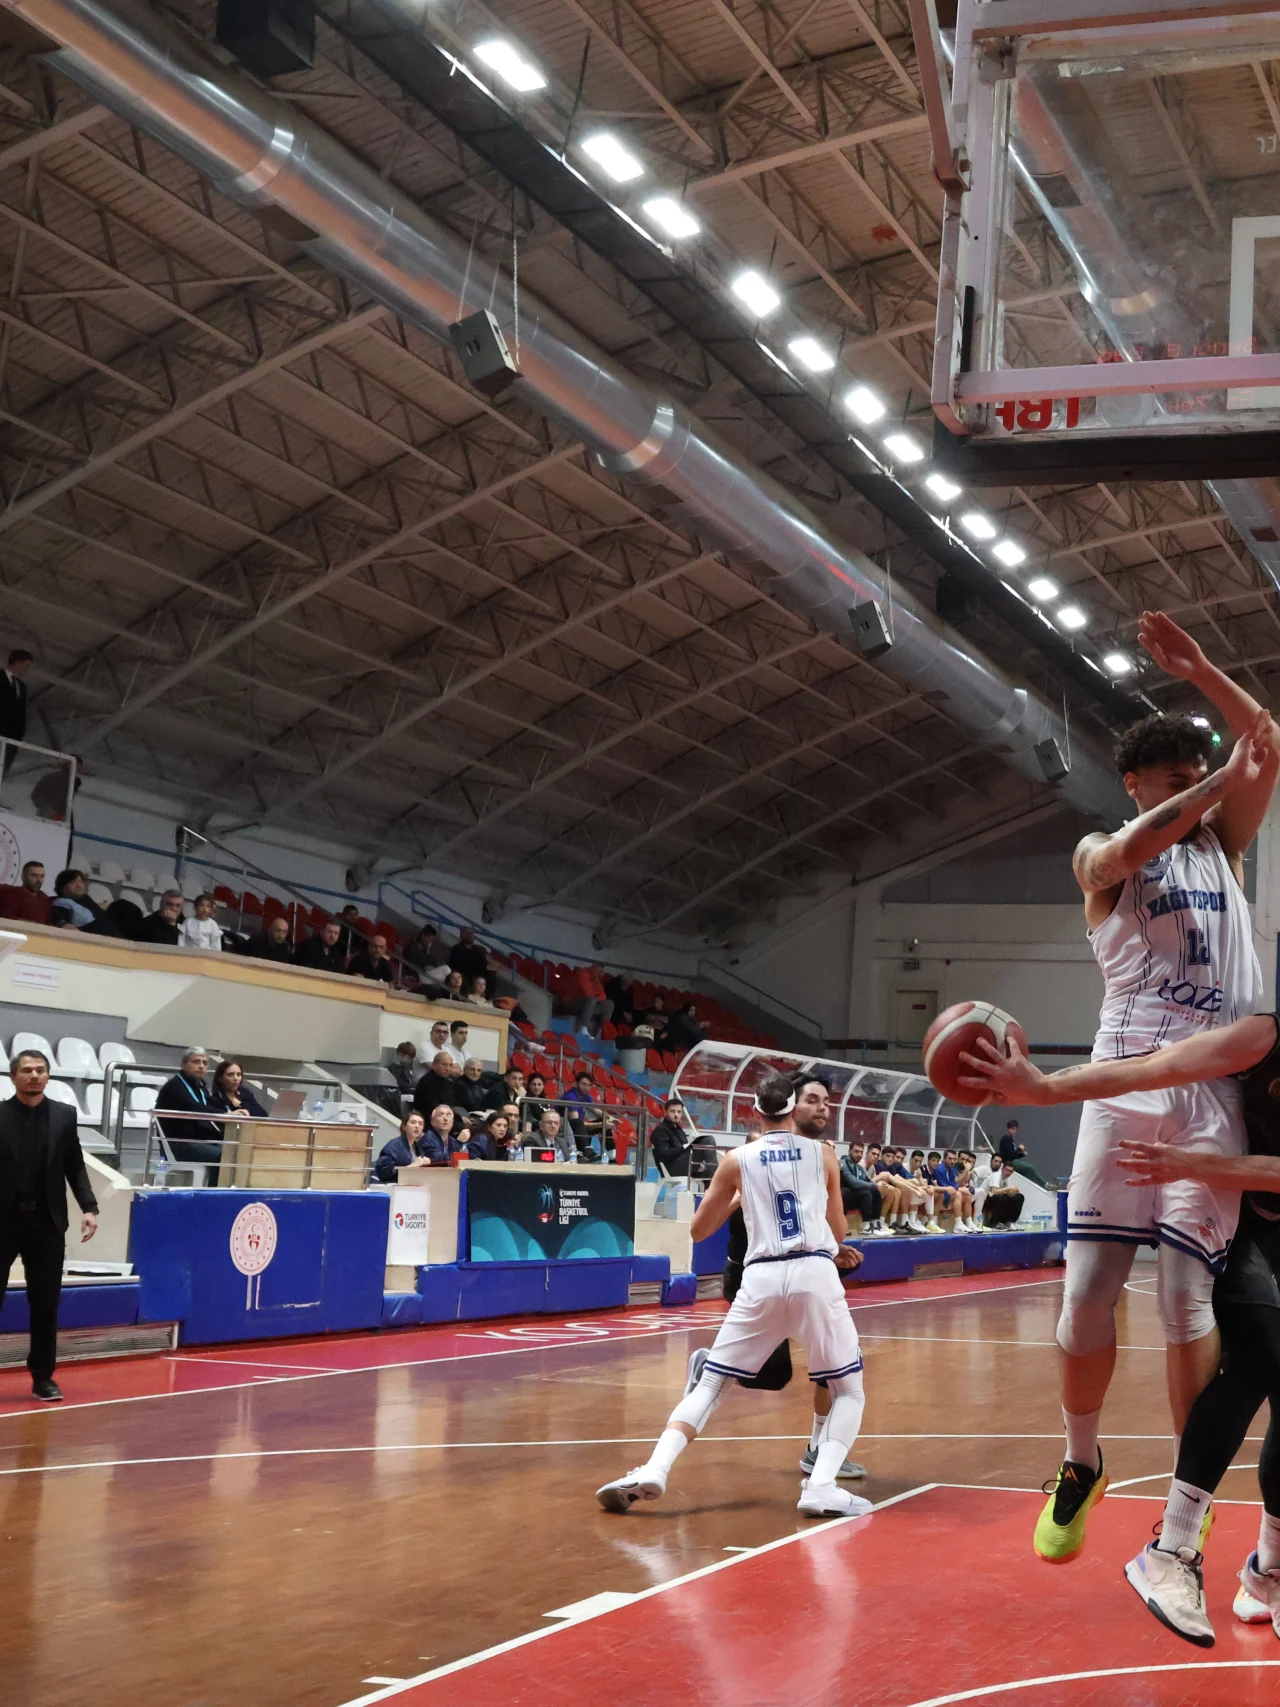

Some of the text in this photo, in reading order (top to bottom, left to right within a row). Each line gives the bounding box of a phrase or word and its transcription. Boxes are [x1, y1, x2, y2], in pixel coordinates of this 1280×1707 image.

[760, 1148, 802, 1166] ŞANLI
[559, 1208, 588, 1216] BASKETBOL
[775, 1190, 802, 1241] 9
